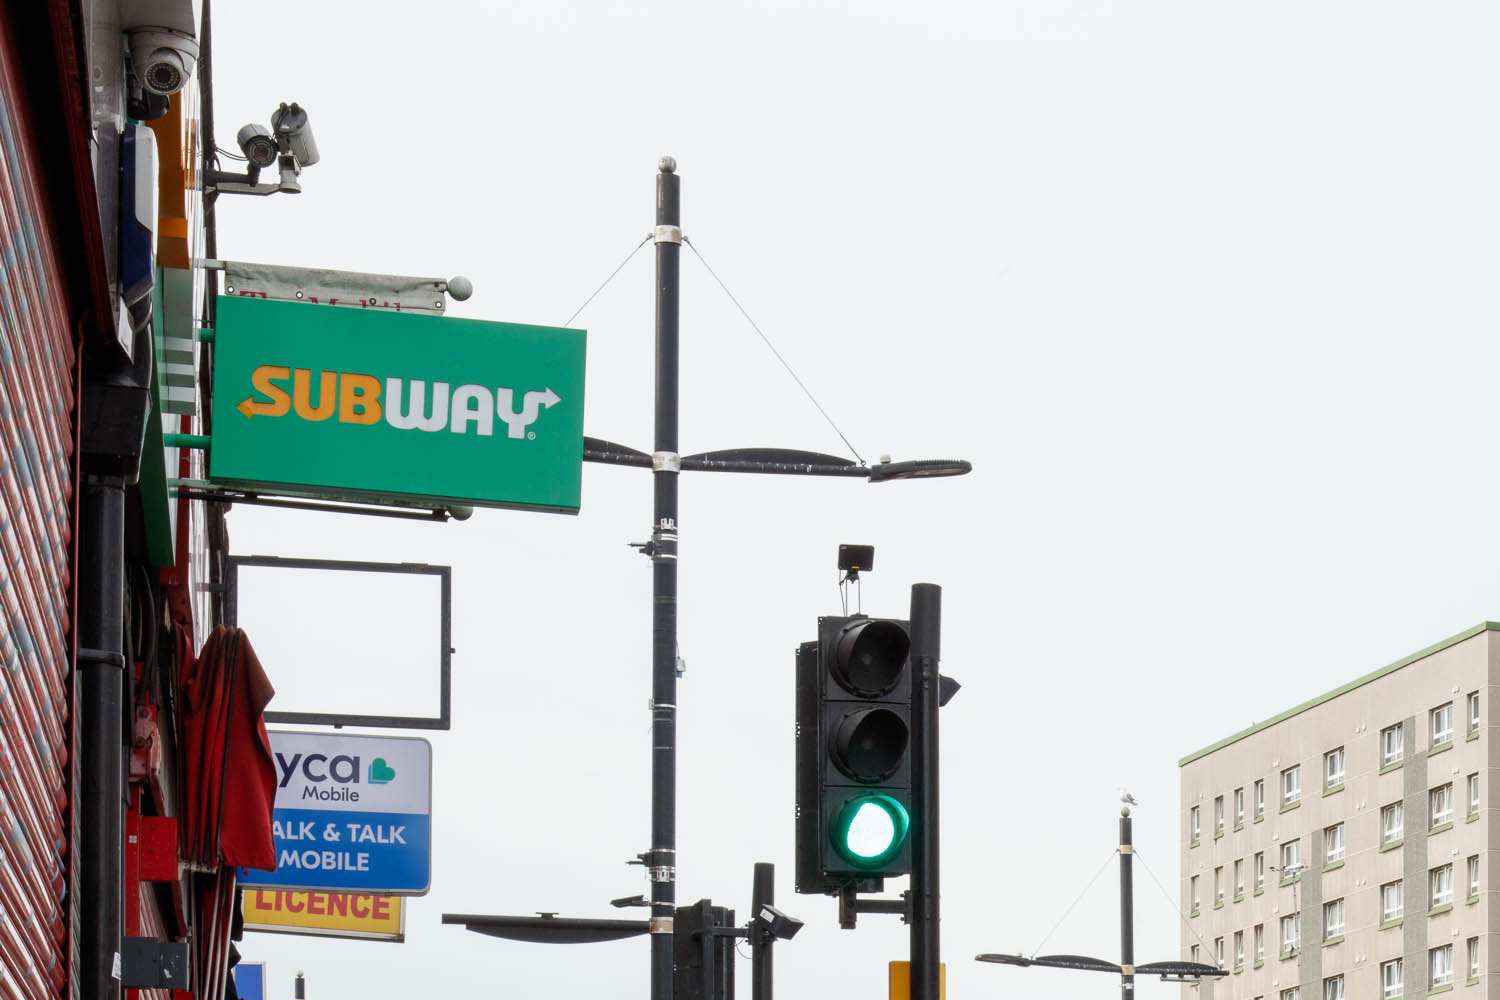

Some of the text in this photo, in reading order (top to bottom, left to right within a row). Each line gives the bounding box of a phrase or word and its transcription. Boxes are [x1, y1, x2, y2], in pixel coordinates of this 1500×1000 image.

[237, 364, 562, 440] SUBWAY
[275, 752, 360, 788] yca
[302, 786, 360, 802] Mobile
[272, 820, 407, 845] ALK & TALK
[278, 850, 370, 872] MOBILE
[255, 889, 391, 920] LICENCE
